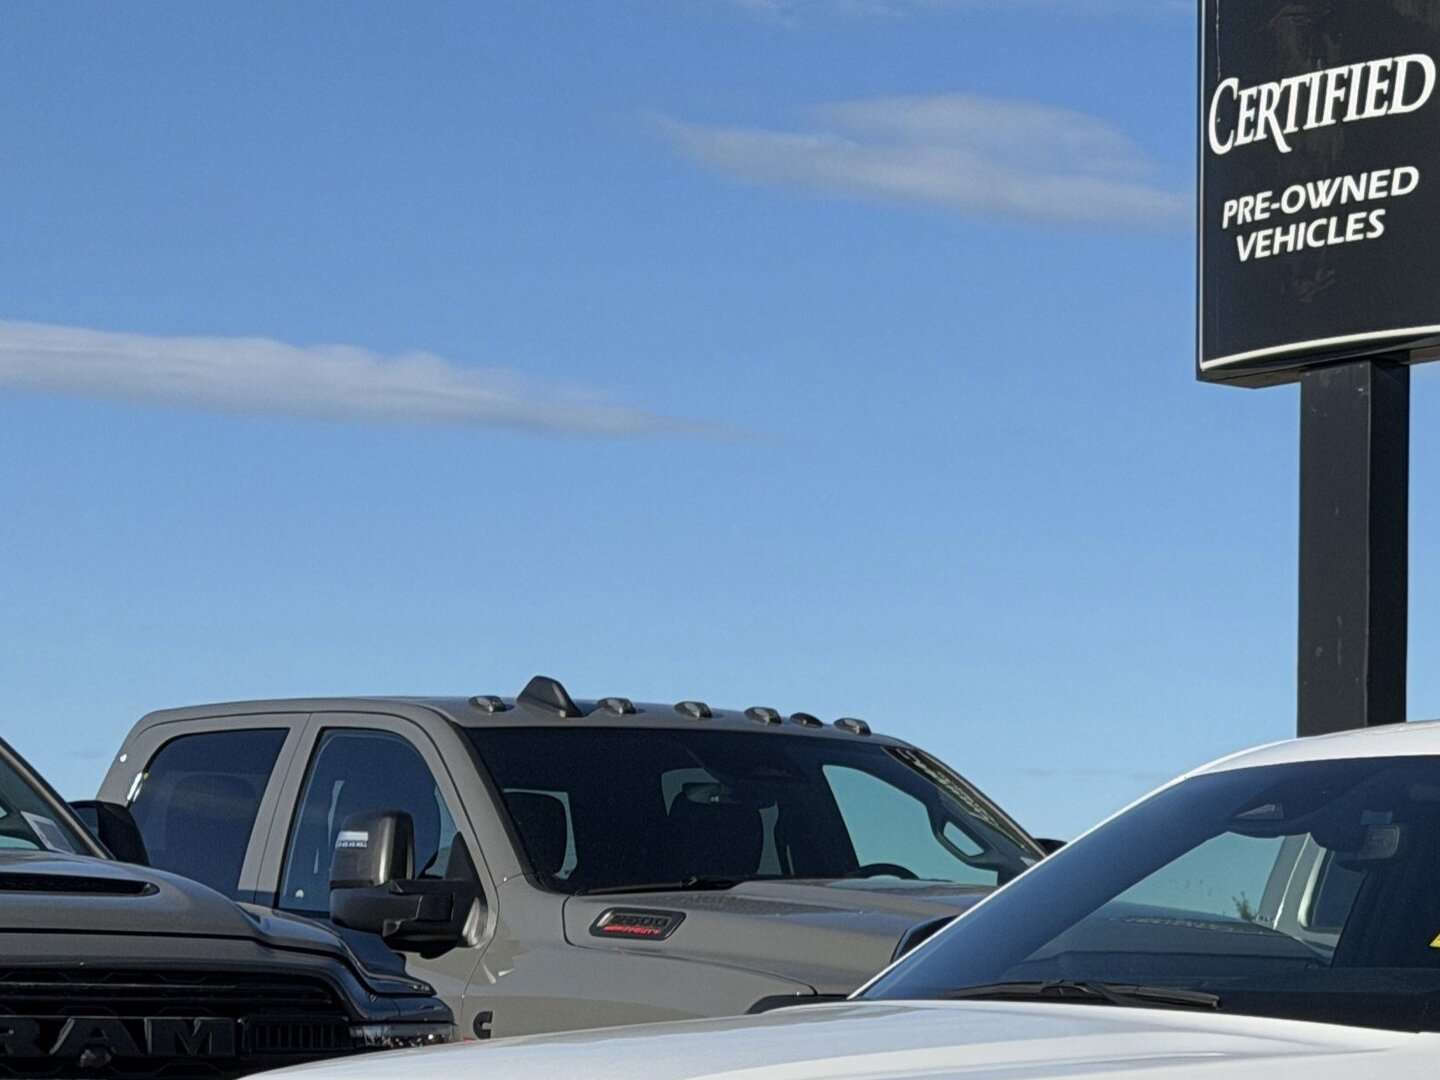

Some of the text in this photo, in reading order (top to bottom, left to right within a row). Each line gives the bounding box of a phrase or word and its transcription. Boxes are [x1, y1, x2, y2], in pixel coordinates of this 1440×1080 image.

[1209, 54, 1436, 154] CERTIFIED
[1222, 166, 1420, 229] PRE-OWNED
[1236, 208, 1386, 262] VEHICLES
